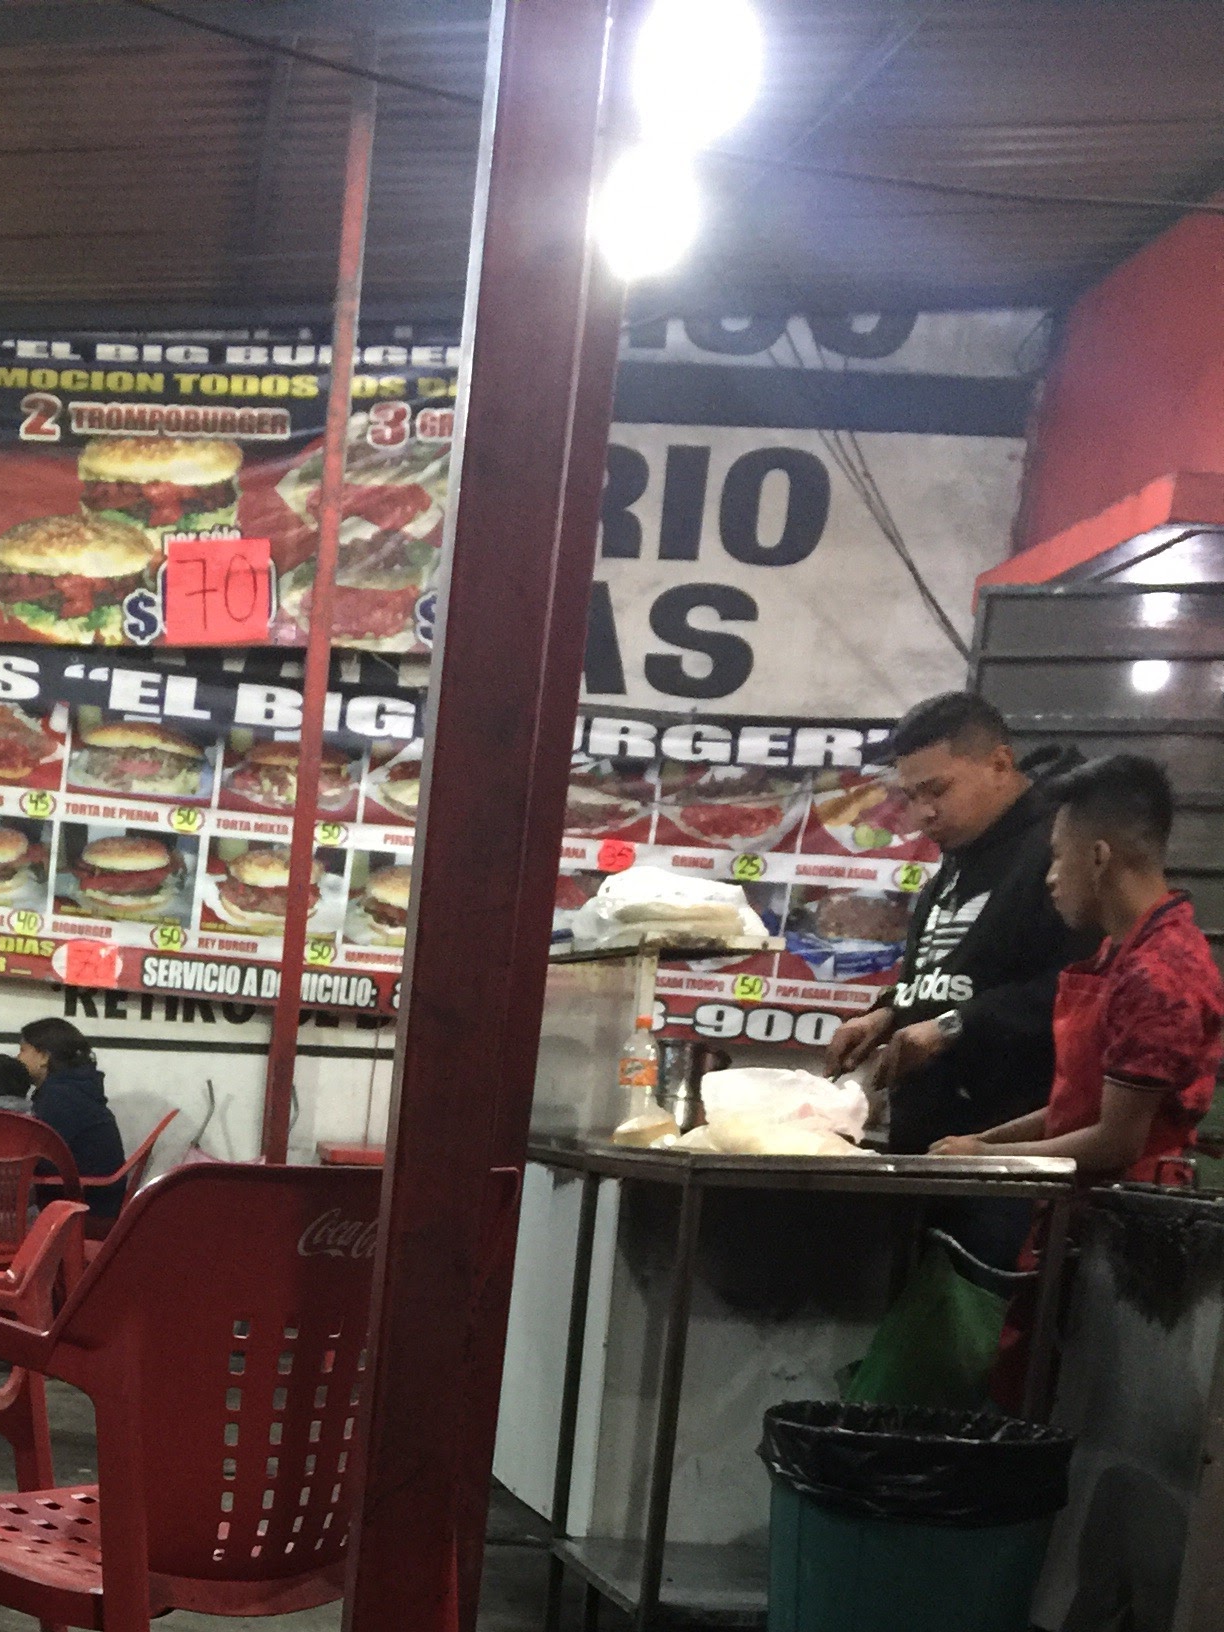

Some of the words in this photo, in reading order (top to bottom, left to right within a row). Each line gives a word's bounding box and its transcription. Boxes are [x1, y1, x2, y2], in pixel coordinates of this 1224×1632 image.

[95, 343, 210, 364] BIG
[174, 373, 320, 397] TODOS
[351, 374, 408, 399] OS
[20, 393, 62, 441] 2
[367, 401, 411, 449] 3
[177, 553, 258, 631] 70
[234, 682, 416, 739] BIG
[65, 802, 101, 817] TORTA
[103, 804, 117, 819] DE
[118, 806, 160, 822] PIERNA
[175, 806, 197, 826] 50
[216, 818, 251, 832] TORTA
[320, 824, 341, 842] 50
[738, 853, 760, 876] 25
[17, 909, 38, 931] 40
[159, 927, 181, 946] 50
[310, 940, 332, 960] 50
[142, 956, 241, 995] SERVICIO
[241, 966, 258, 997] A
[740, 975, 764, 996] 50
